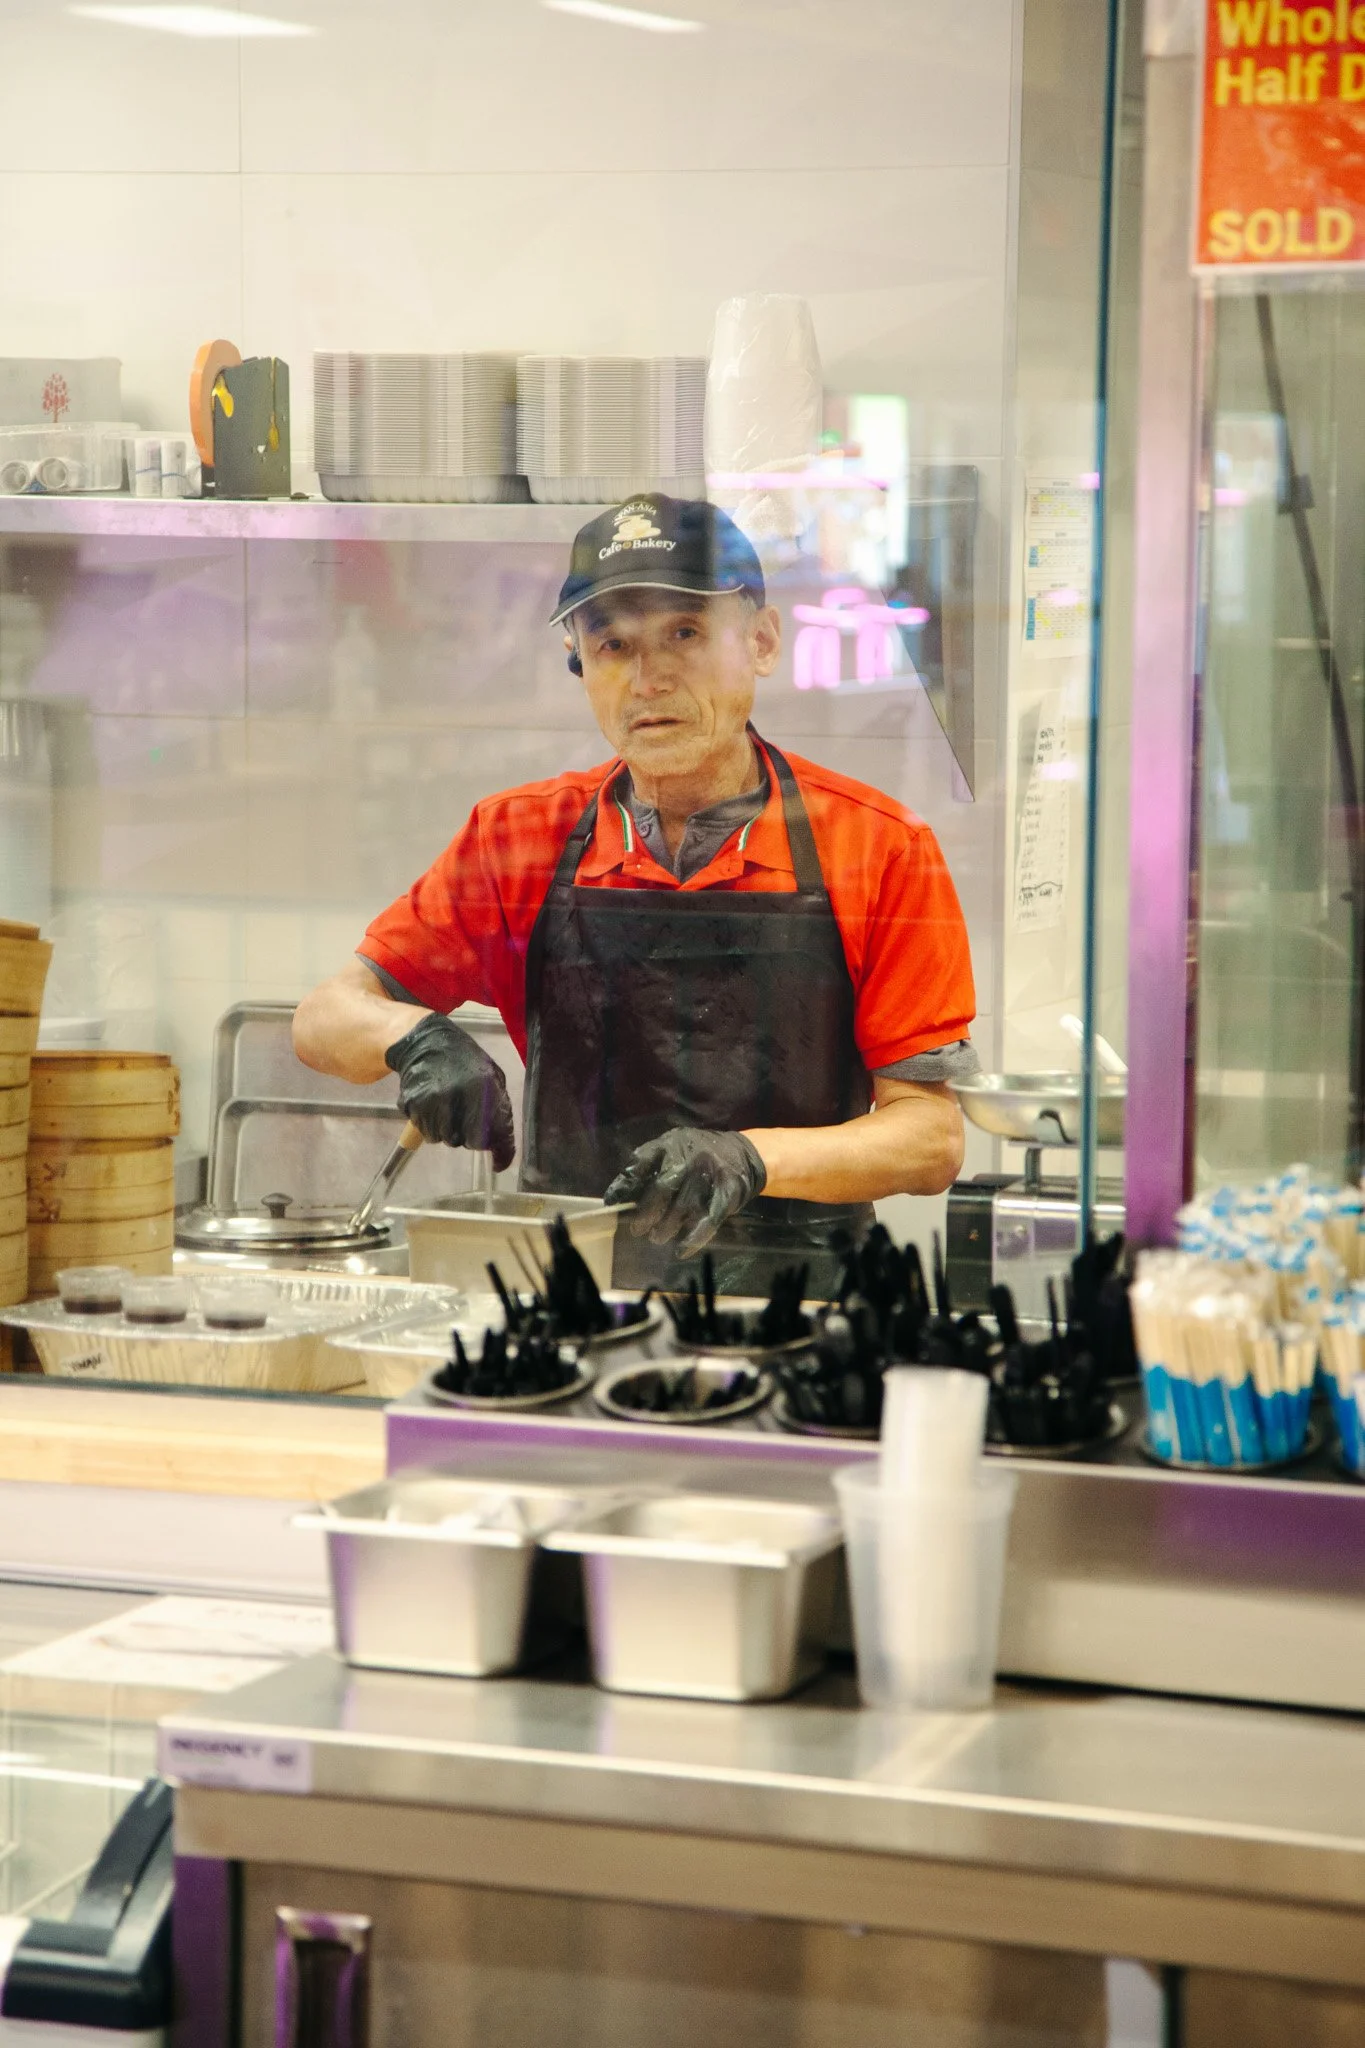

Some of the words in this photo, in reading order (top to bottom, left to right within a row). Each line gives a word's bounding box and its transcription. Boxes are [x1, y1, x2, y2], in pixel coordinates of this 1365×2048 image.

[1214, 53, 1328, 106] Half
[1207, 207, 1355, 258] SOLD
[599, 542, 622, 559] Cafe
[633, 538, 676, 551] Bakery
